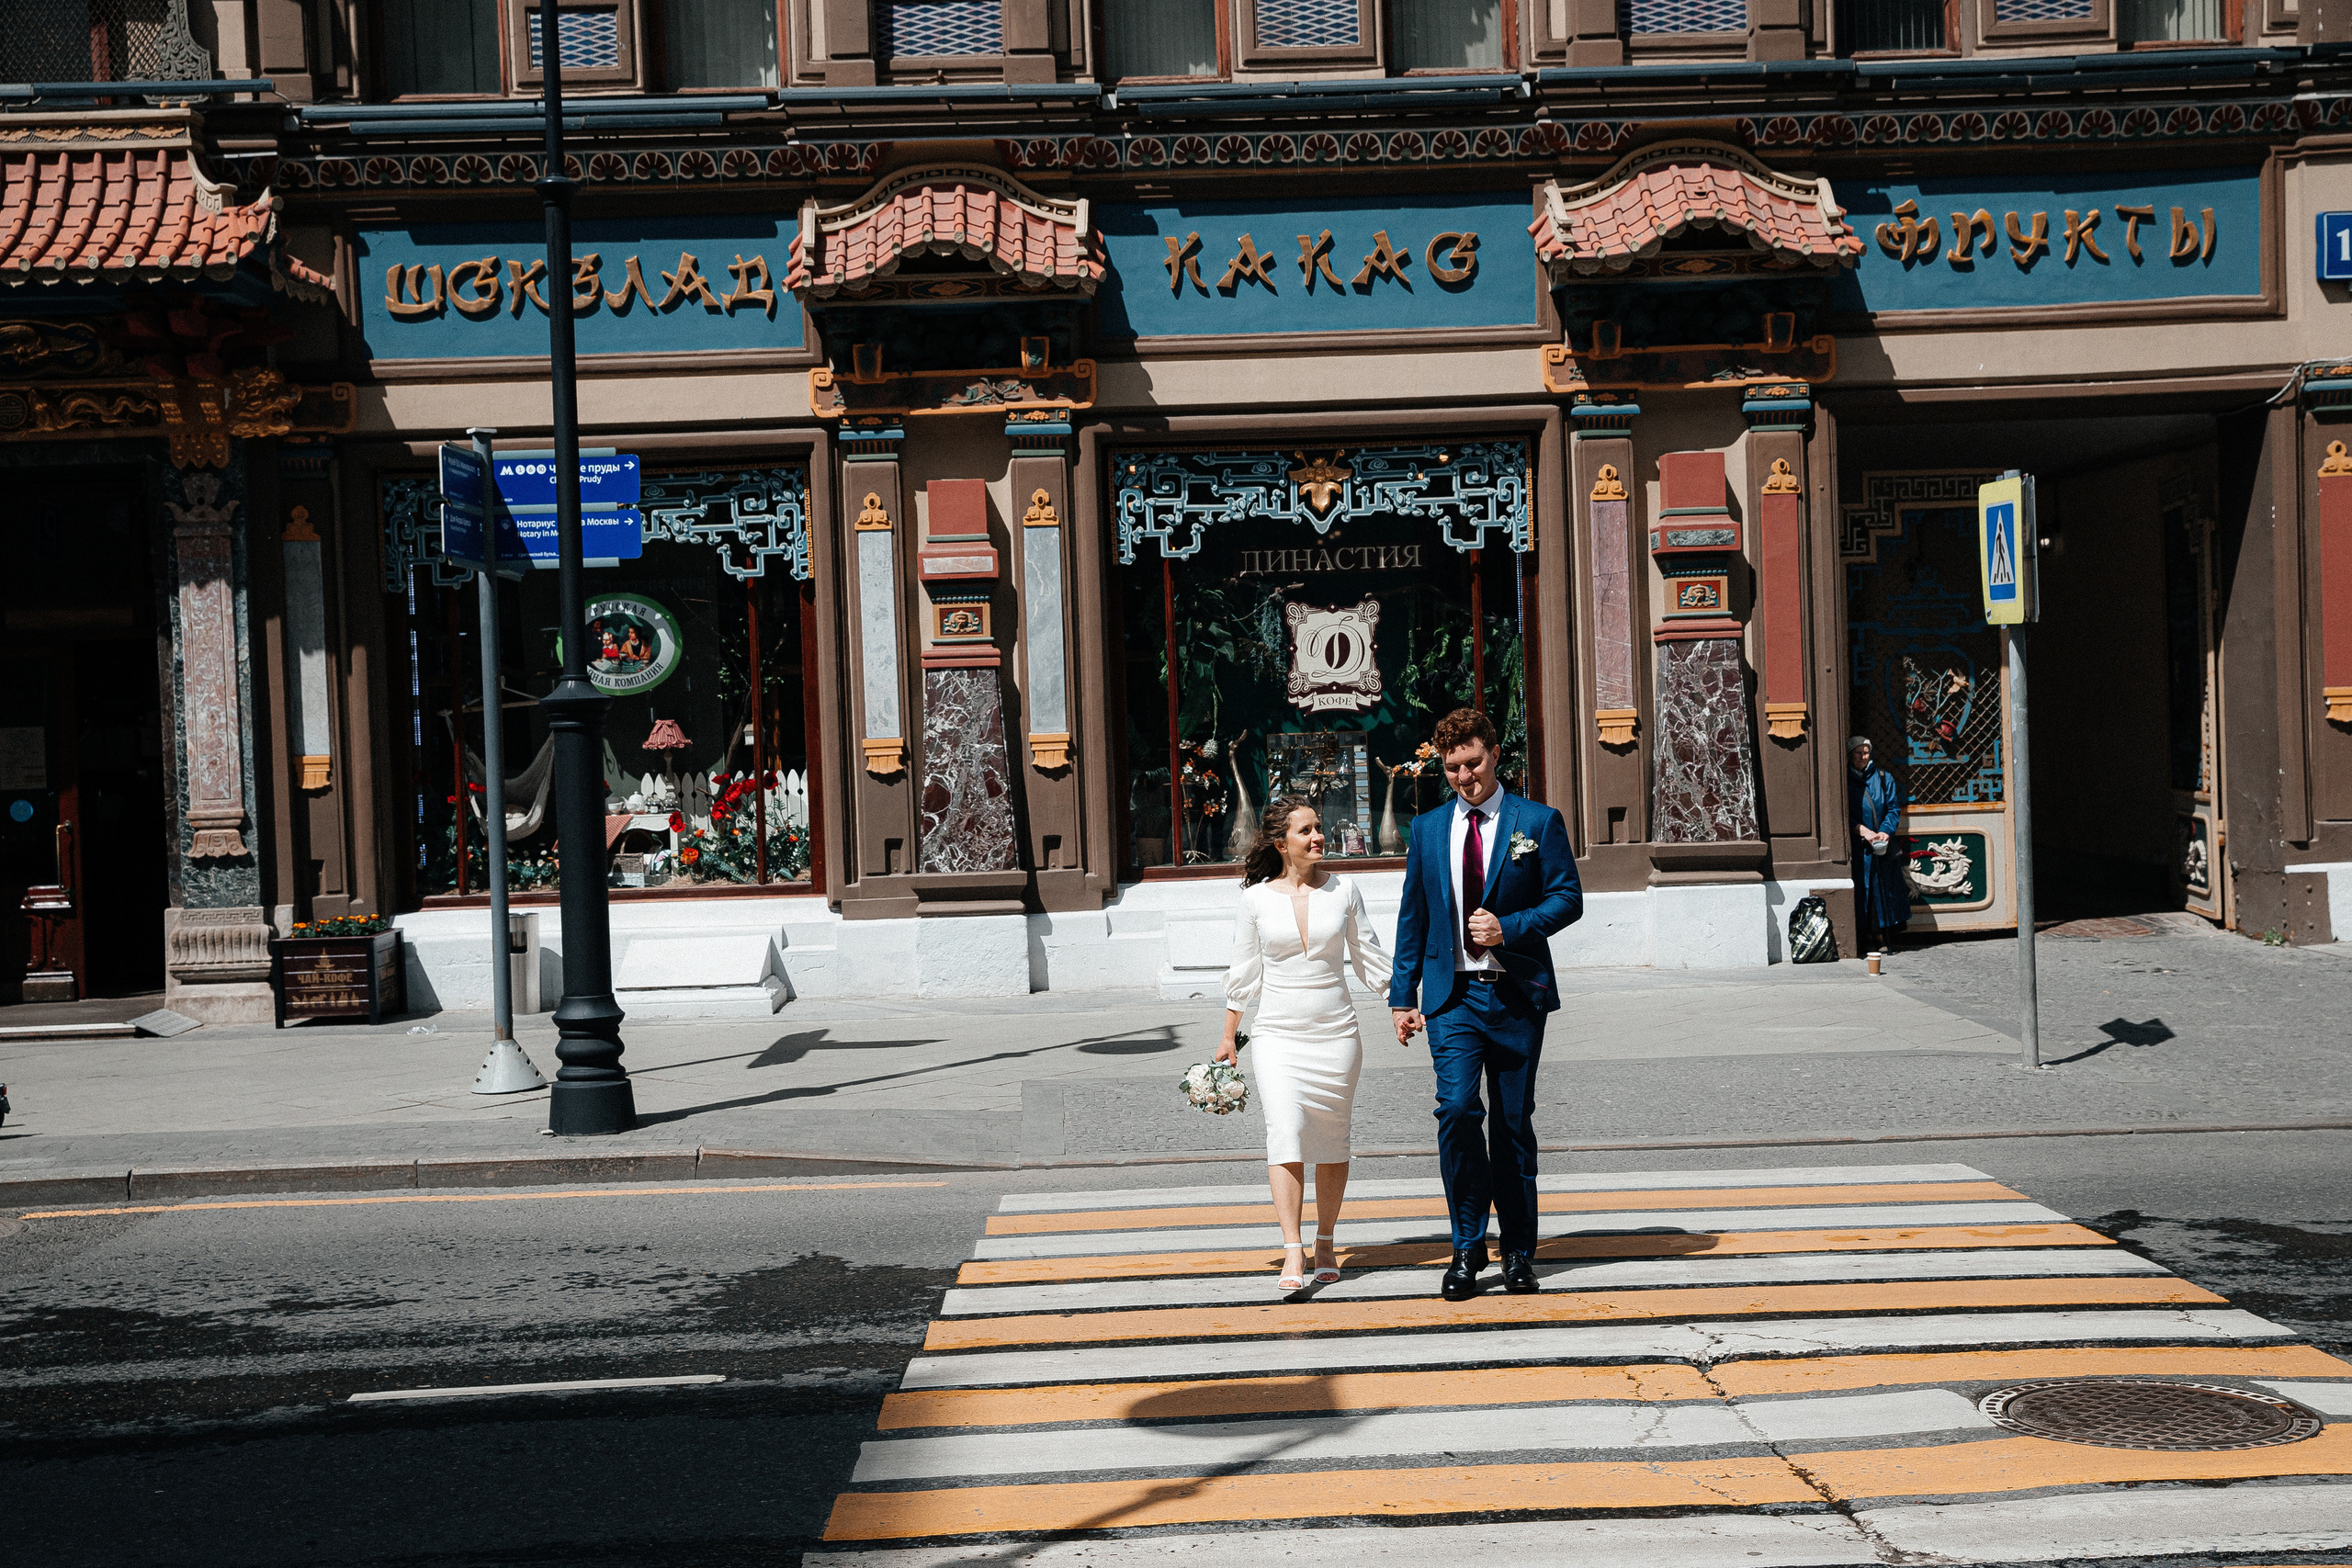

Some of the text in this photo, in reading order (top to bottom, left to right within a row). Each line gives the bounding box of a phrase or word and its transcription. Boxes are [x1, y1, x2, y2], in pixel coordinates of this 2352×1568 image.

[1875, 198, 2216, 265] ФРУКТЫ
[1164, 229, 1478, 290] КАКАО
[588, 464, 620, 475] пруды
[579, 475, 602, 485] Prudy
[516, 520, 556, 529] Нотариус
[586, 517, 619, 526] Москвы
[517, 531, 542, 539] Notary
[542, 529, 549, 537] in
[1240, 545, 1421, 577] ДИНАСТИЯ
[593, 602, 647, 616] РУССКАЯ
[614, 662, 664, 687] КОМПАНИЯ
[1318, 696, 1352, 706] КОФЕ
[297, 972, 353, 984] ЧАЙ-КОФЕ
